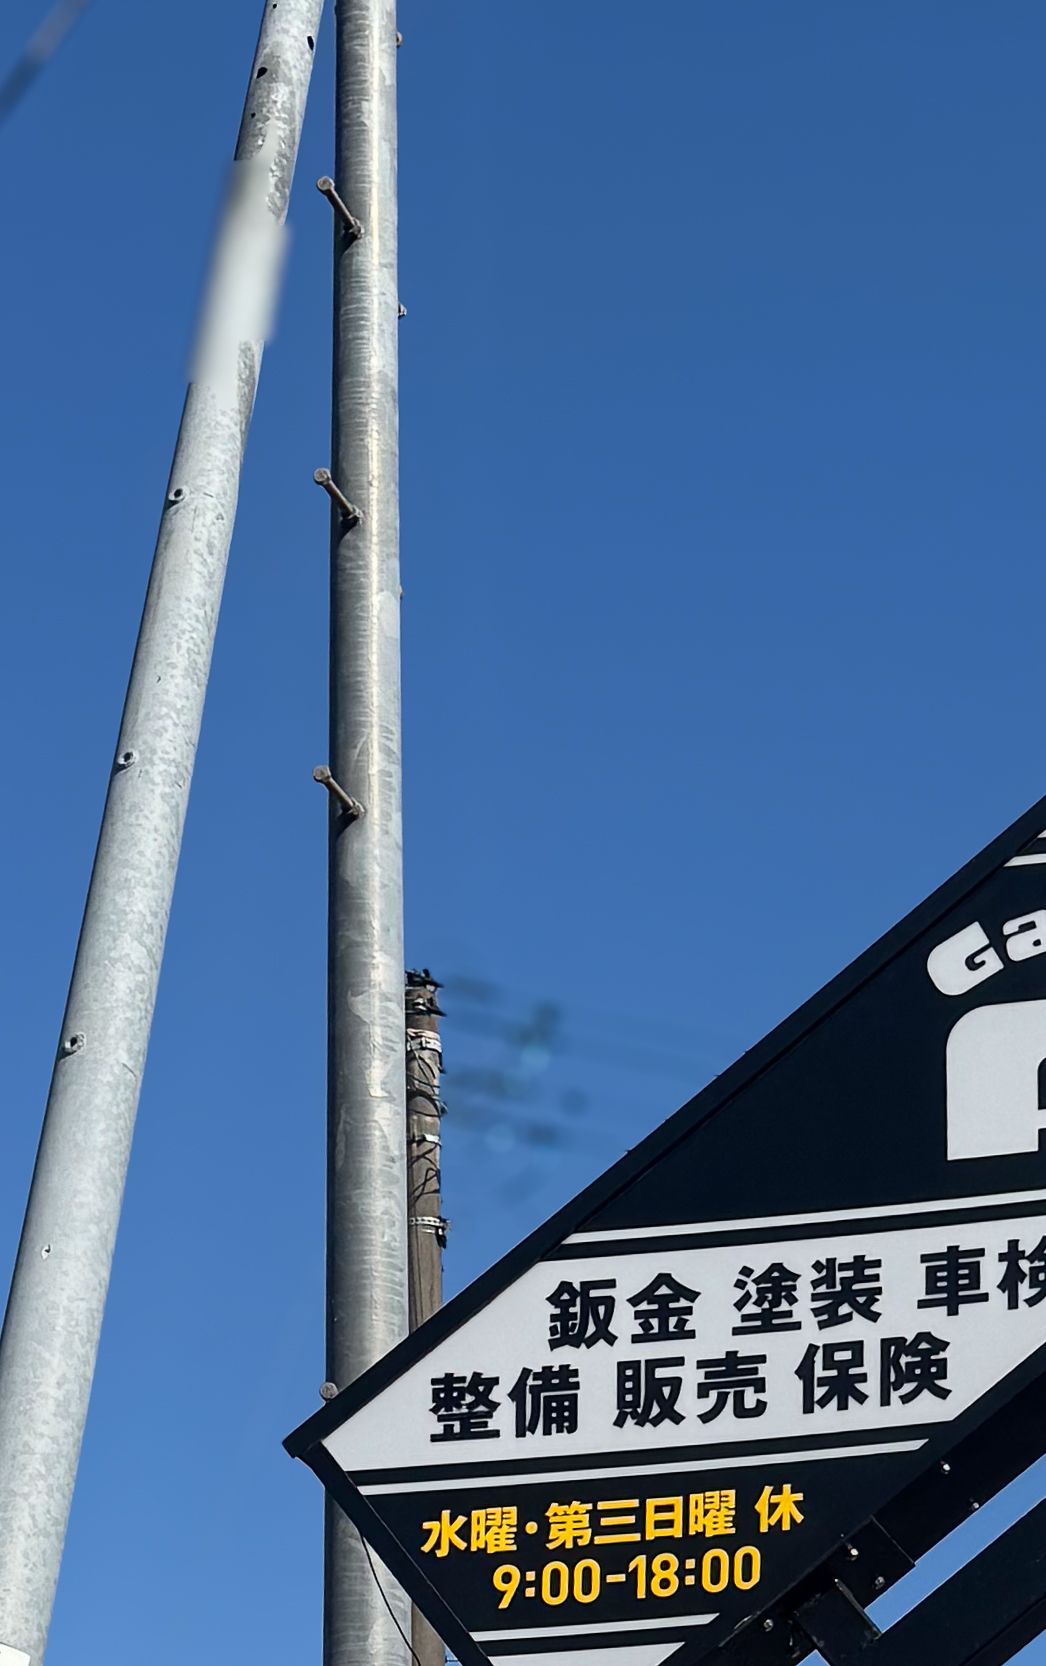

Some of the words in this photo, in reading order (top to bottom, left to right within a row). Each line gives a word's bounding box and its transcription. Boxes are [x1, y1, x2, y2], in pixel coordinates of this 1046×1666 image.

[546, 1272, 702, 1352] 鈑金
[732, 1254, 883, 1336] 塗装
[429, 1363, 581, 1443] 整備
[612, 1350, 768, 1429] 販売
[794, 1331, 952, 1415] 保険
[420, 1489, 737, 1558] 水曜・第三日曜
[754, 1484, 804, 1534] 休
[492, 1546, 761, 1610] 9:00-18:00
